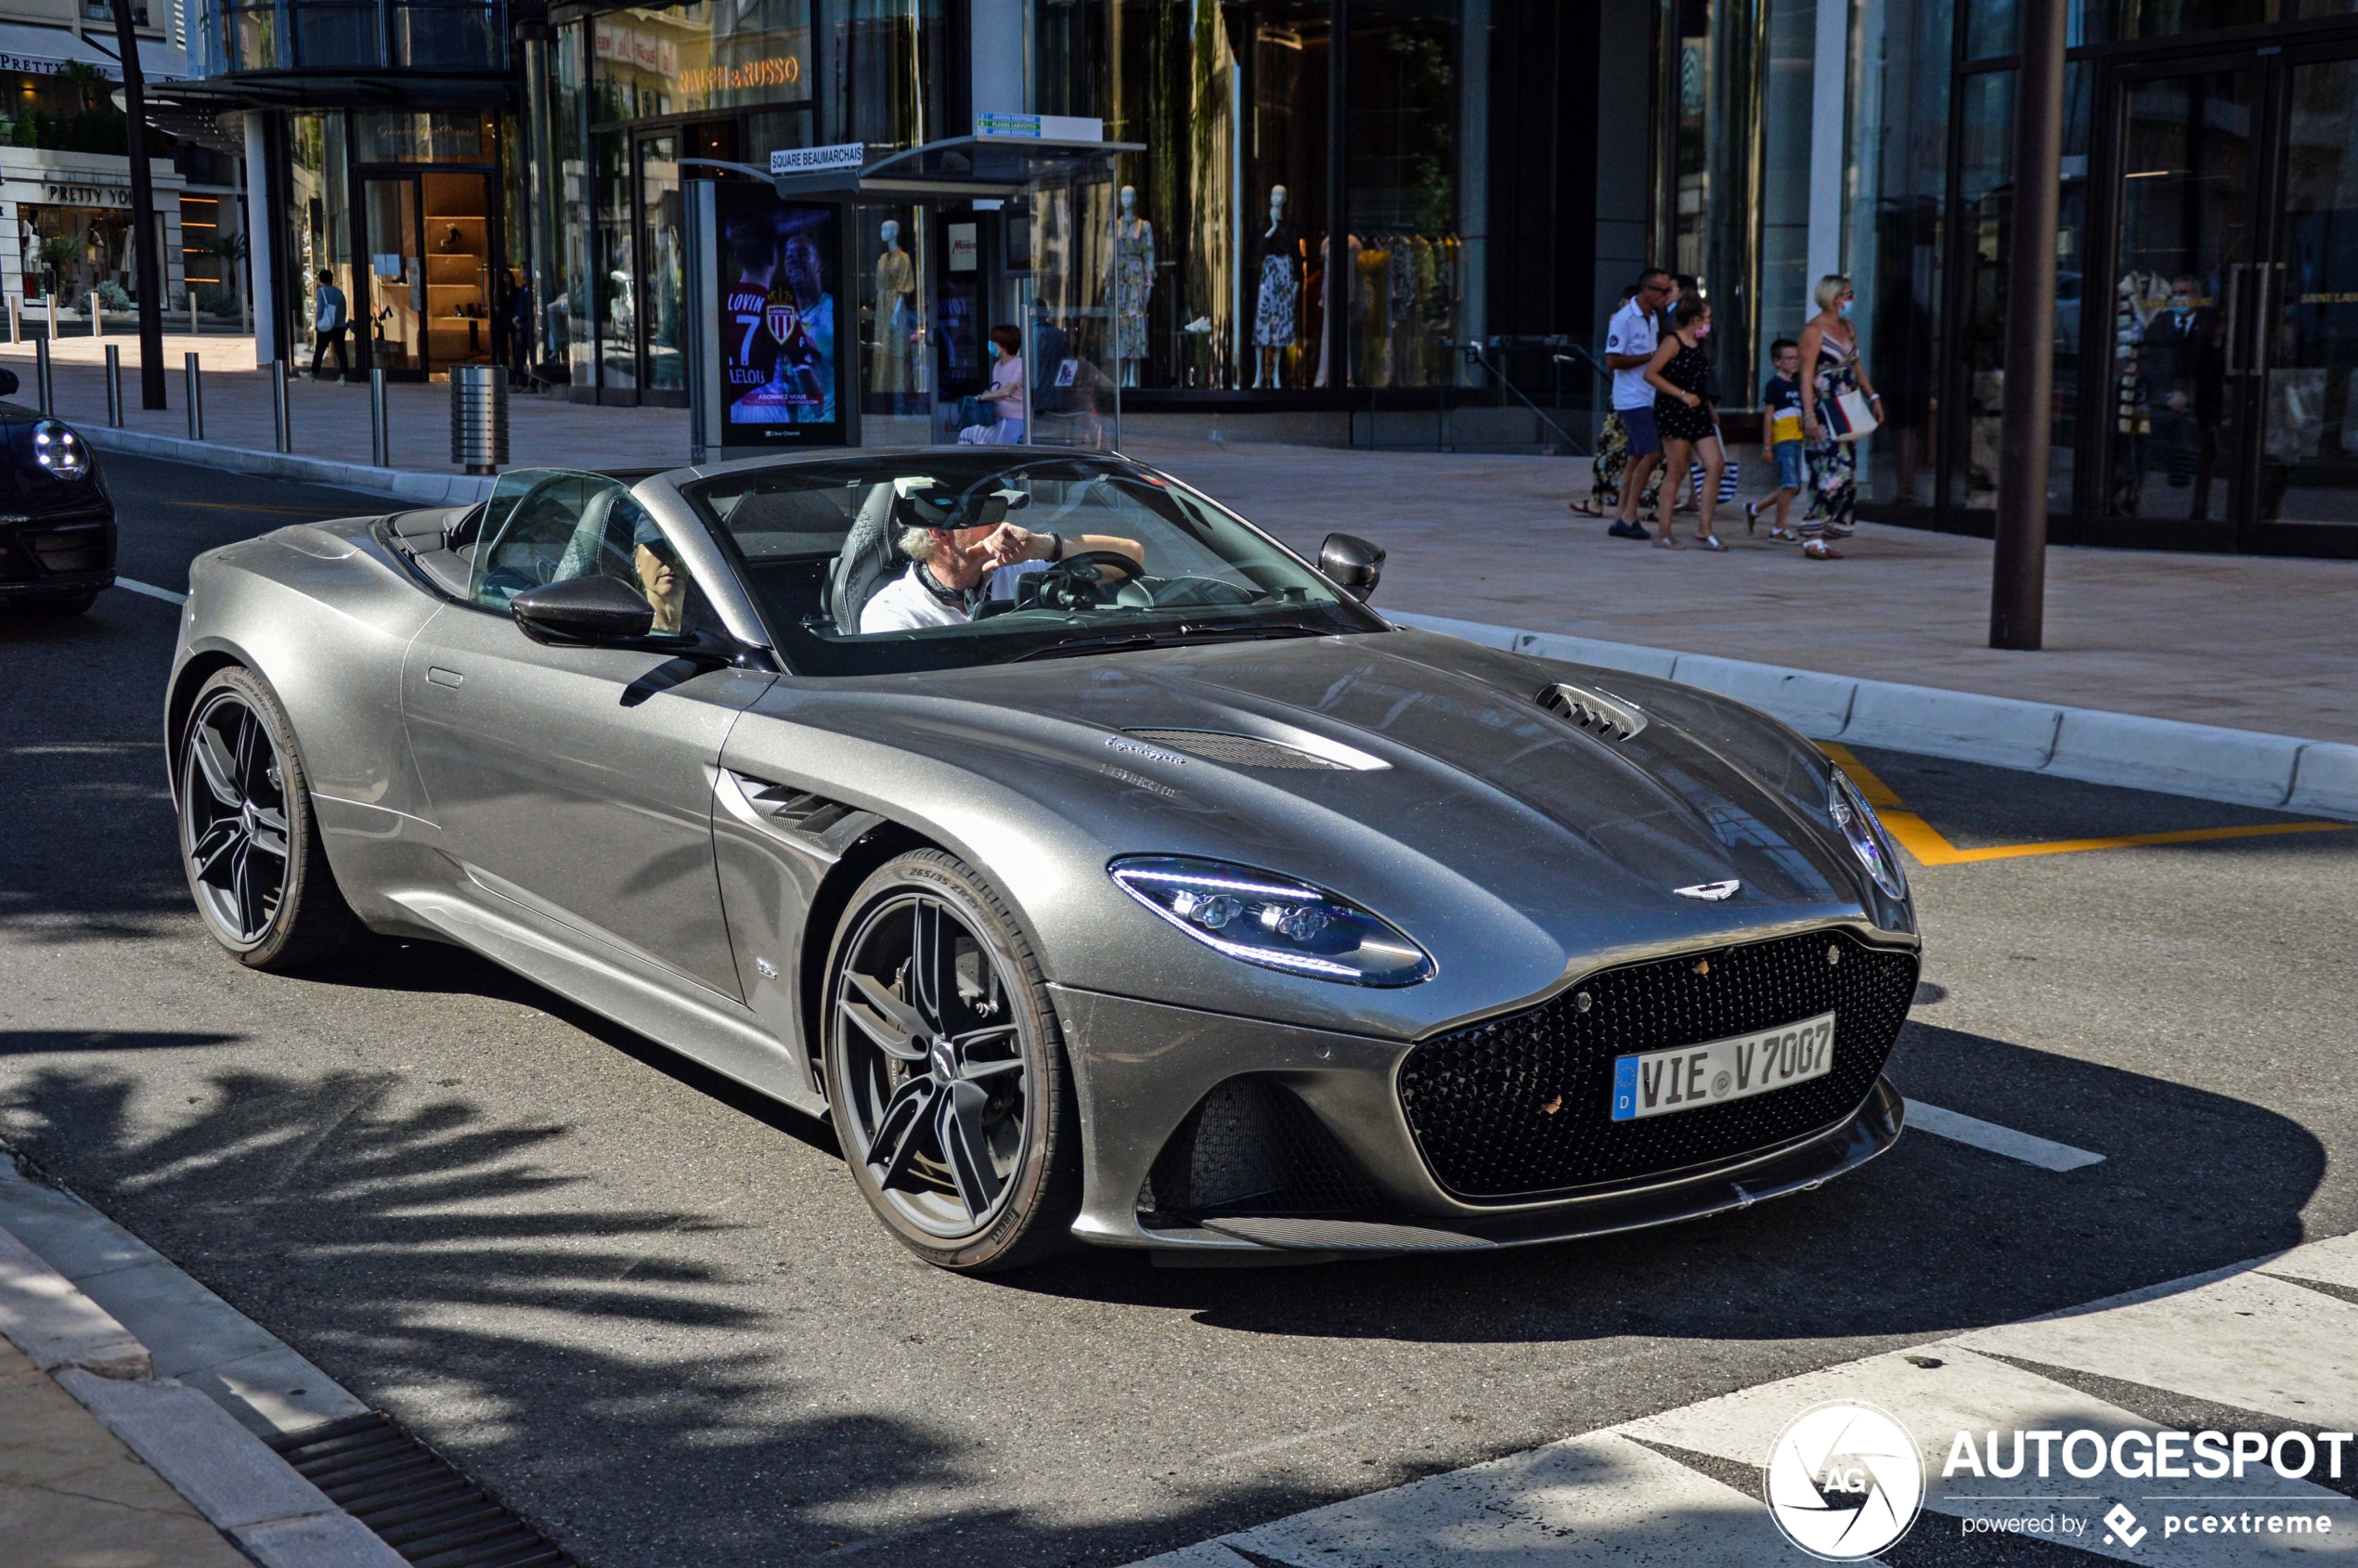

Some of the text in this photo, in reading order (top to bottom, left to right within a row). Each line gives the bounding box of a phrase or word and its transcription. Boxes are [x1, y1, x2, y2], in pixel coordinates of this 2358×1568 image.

[1, 54, 65, 74] PRETTY
[680, 65, 729, 94] RALPH
[744, 56, 798, 87] RUSSO
[771, 147, 862, 168] SQUARE BEAUMARCHAIS
[50, 186, 102, 203] PRETTY
[728, 293, 765, 314] LOVIN
[736, 315, 760, 366] 7
[729, 369, 765, 384] LELOU
[910, 869, 951, 886] 265/35
[1642, 1051, 1709, 1108] VIE
[1619, 1095, 1629, 1109] D
